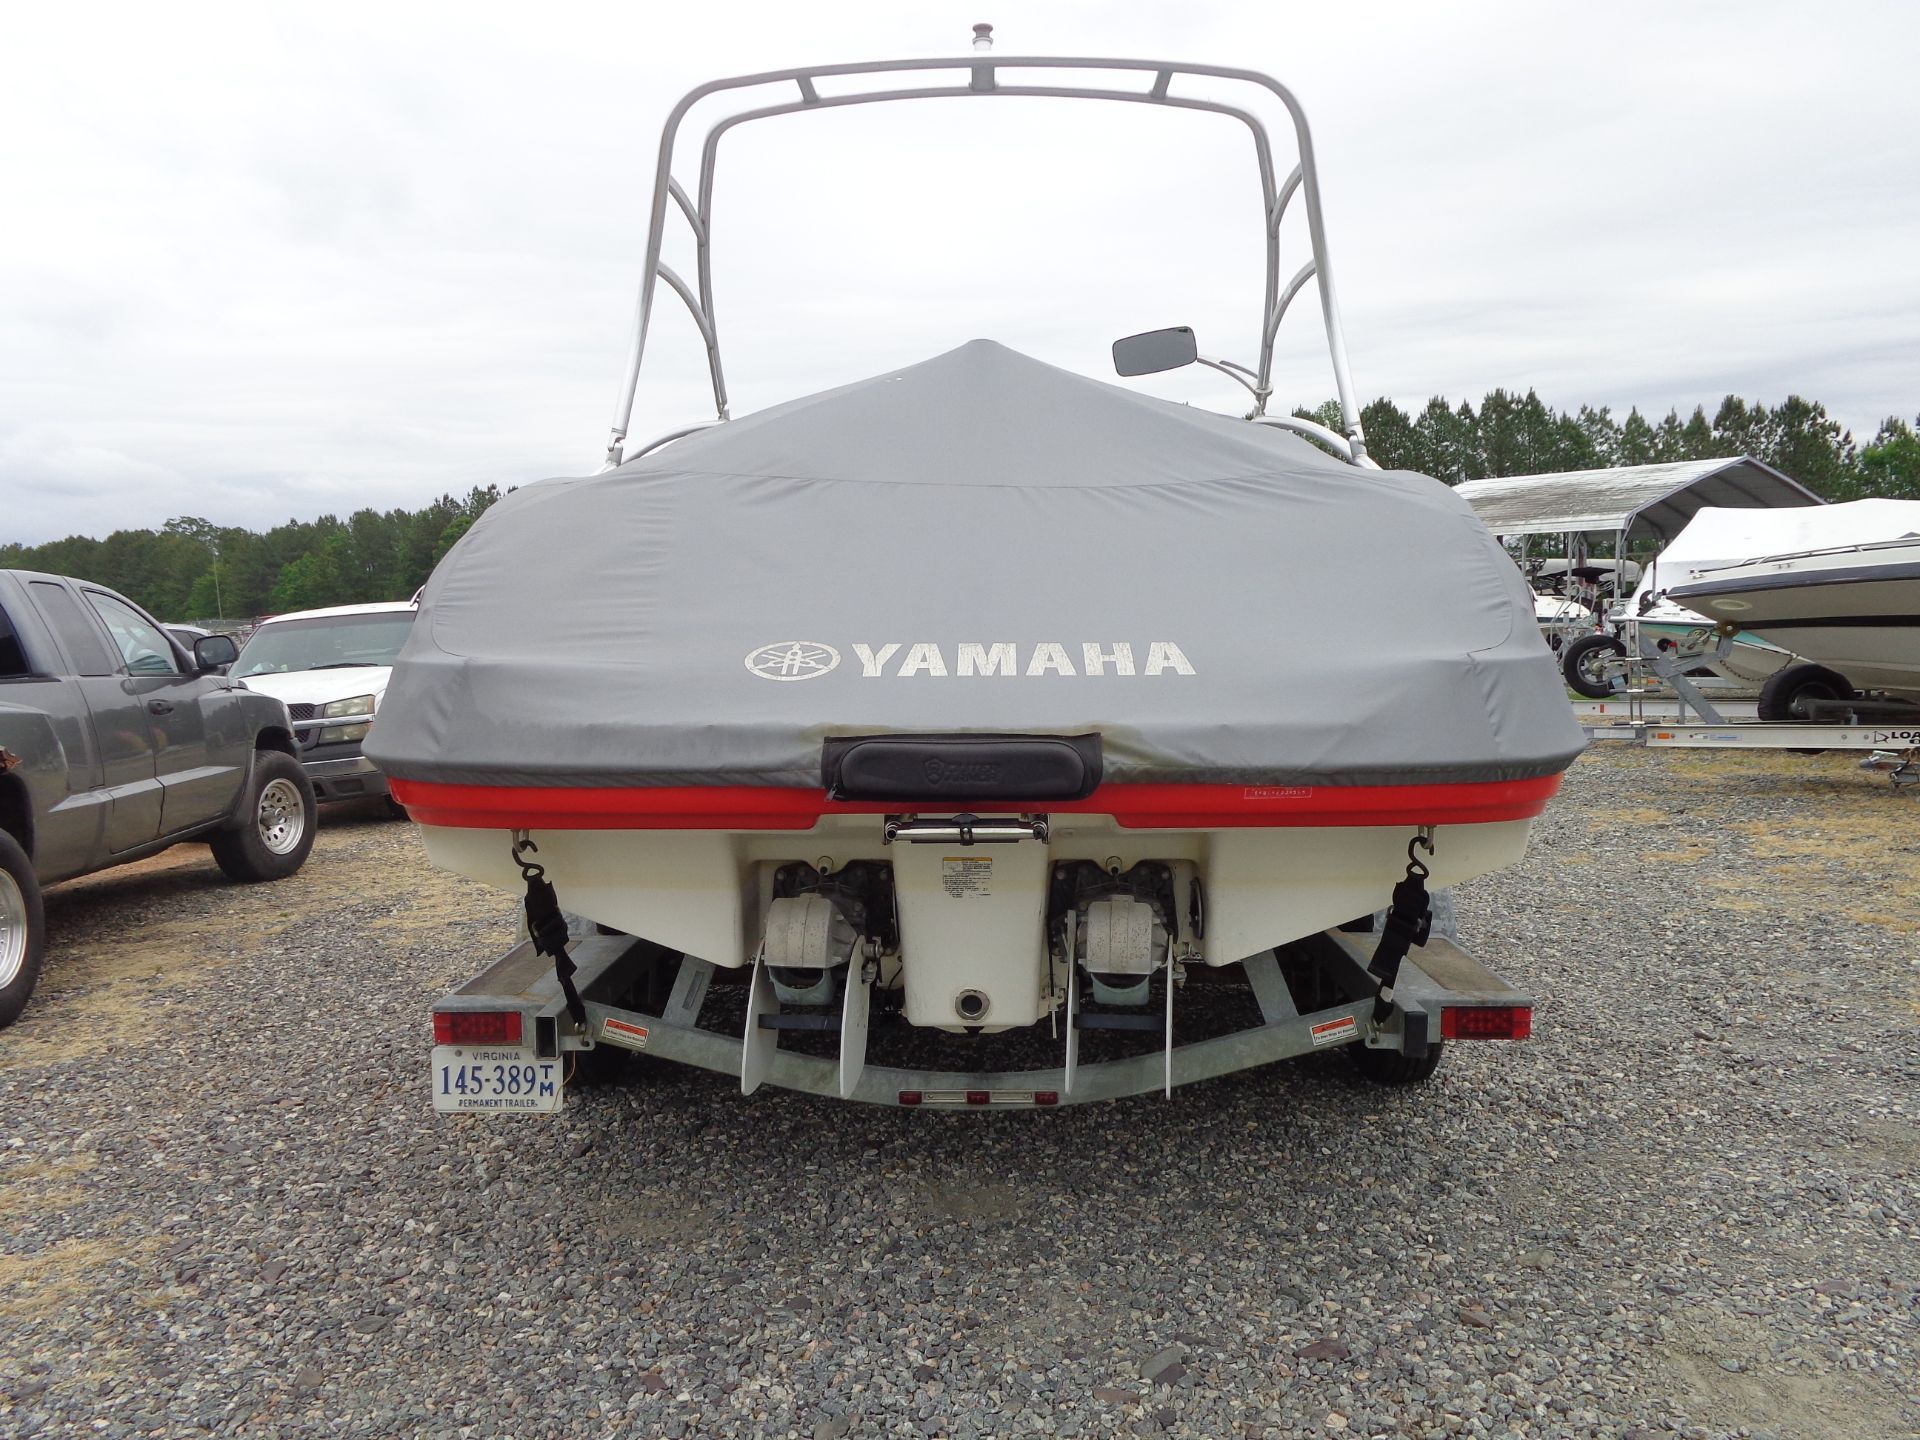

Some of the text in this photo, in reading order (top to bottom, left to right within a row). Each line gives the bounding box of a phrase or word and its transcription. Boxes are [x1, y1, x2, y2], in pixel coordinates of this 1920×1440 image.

[852, 642, 1196, 677] YAMAHA
[472, 1051, 521, 1060] VIRGINIA
[441, 1065, 536, 1095] 145-389
[458, 1099, 536, 1108] PERMANENT TRAILER
